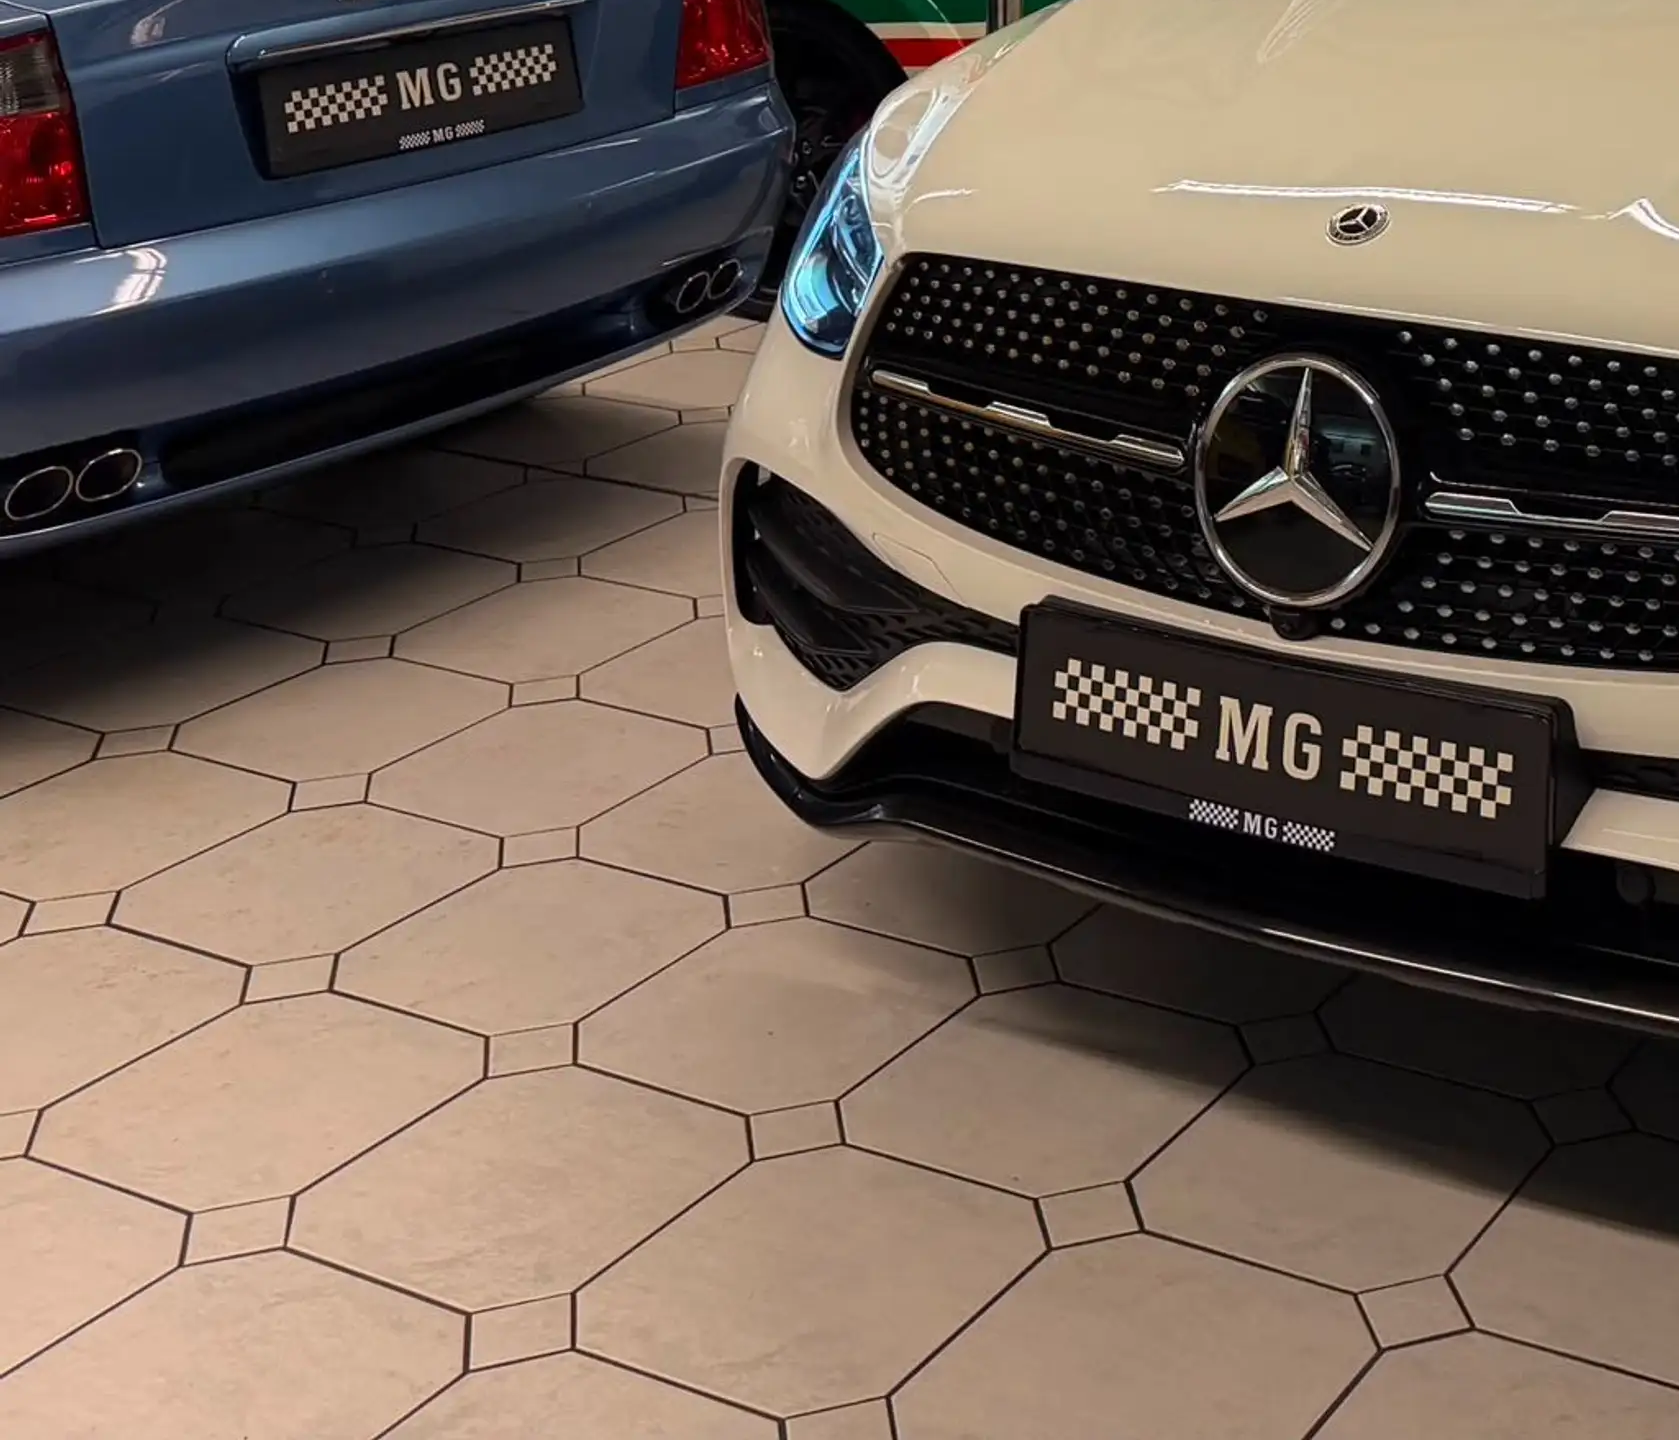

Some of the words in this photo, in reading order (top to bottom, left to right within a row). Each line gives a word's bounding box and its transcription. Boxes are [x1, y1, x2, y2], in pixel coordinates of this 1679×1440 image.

[396, 62, 463, 111] MG
[433, 125, 455, 142] MG
[1215, 695, 1324, 782] MG
[1243, 811, 1278, 841] MG
